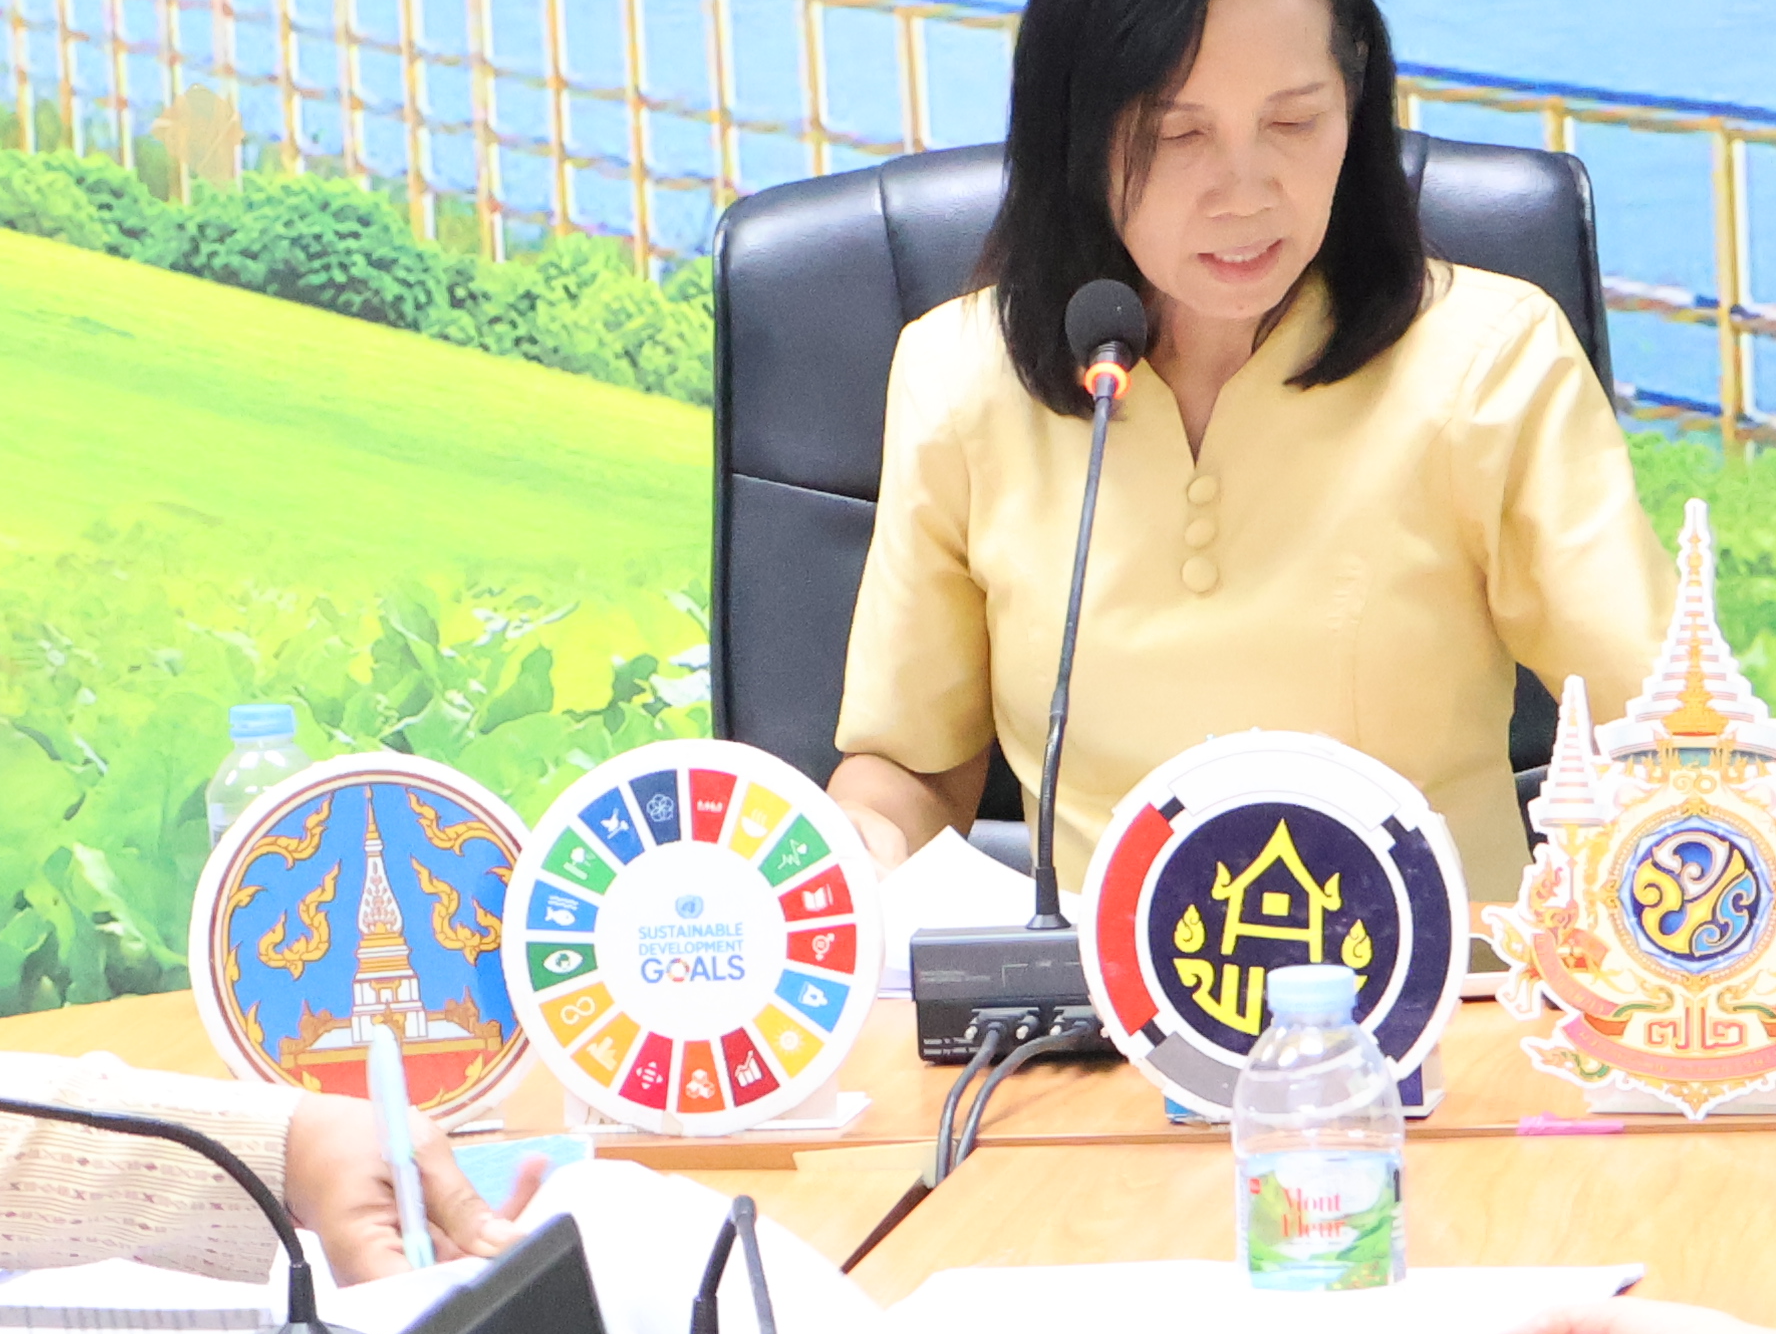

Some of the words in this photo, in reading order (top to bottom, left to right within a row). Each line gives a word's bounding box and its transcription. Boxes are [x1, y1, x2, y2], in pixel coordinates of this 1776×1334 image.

[638, 922, 744, 940] SUSTAINABLE
[638, 939, 744, 956] DEVELOPMENT
[640, 954, 746, 984] GOALS
